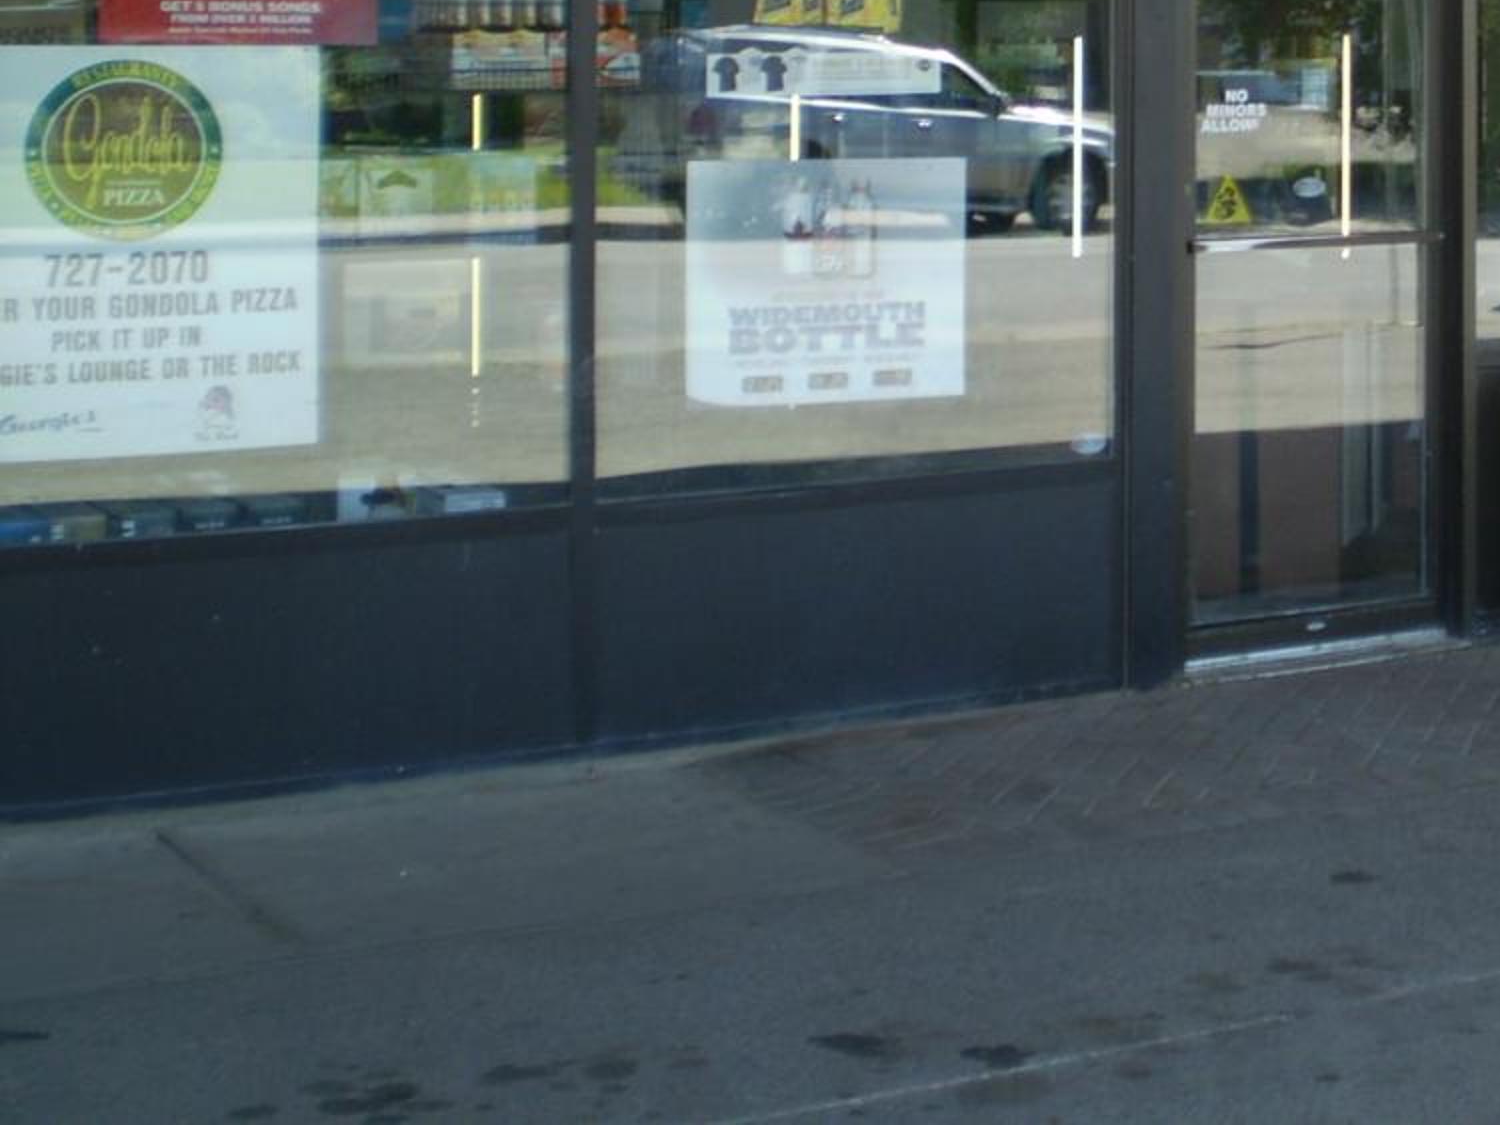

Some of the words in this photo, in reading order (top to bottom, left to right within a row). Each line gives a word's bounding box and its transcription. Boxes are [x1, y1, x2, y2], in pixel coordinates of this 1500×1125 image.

[1206, 103, 1267, 118] MINORS
[1225, 89, 1249, 103] NO
[63, 92, 193, 208] Gondola
[103, 187, 165, 207] PIZZA
[44, 249, 210, 288] 727-2070
[32, 295, 97, 322] YOUR
[109, 291, 220, 319] GONDOLA
[231, 287, 300, 314] PIZZA
[728, 301, 926, 326] WIDEMOUTH
[51, 329, 101, 353] PICK
[113, 328, 134, 351] IT
[142, 327, 170, 350] UP
[179, 325, 202, 348] IN
[728, 322, 926, 355] BOTTLE
[68, 358, 151, 384] LOUNGE
[161, 355, 190, 380] OR
[200, 354, 239, 377] THE
[247, 350, 302, 375] ROCK
